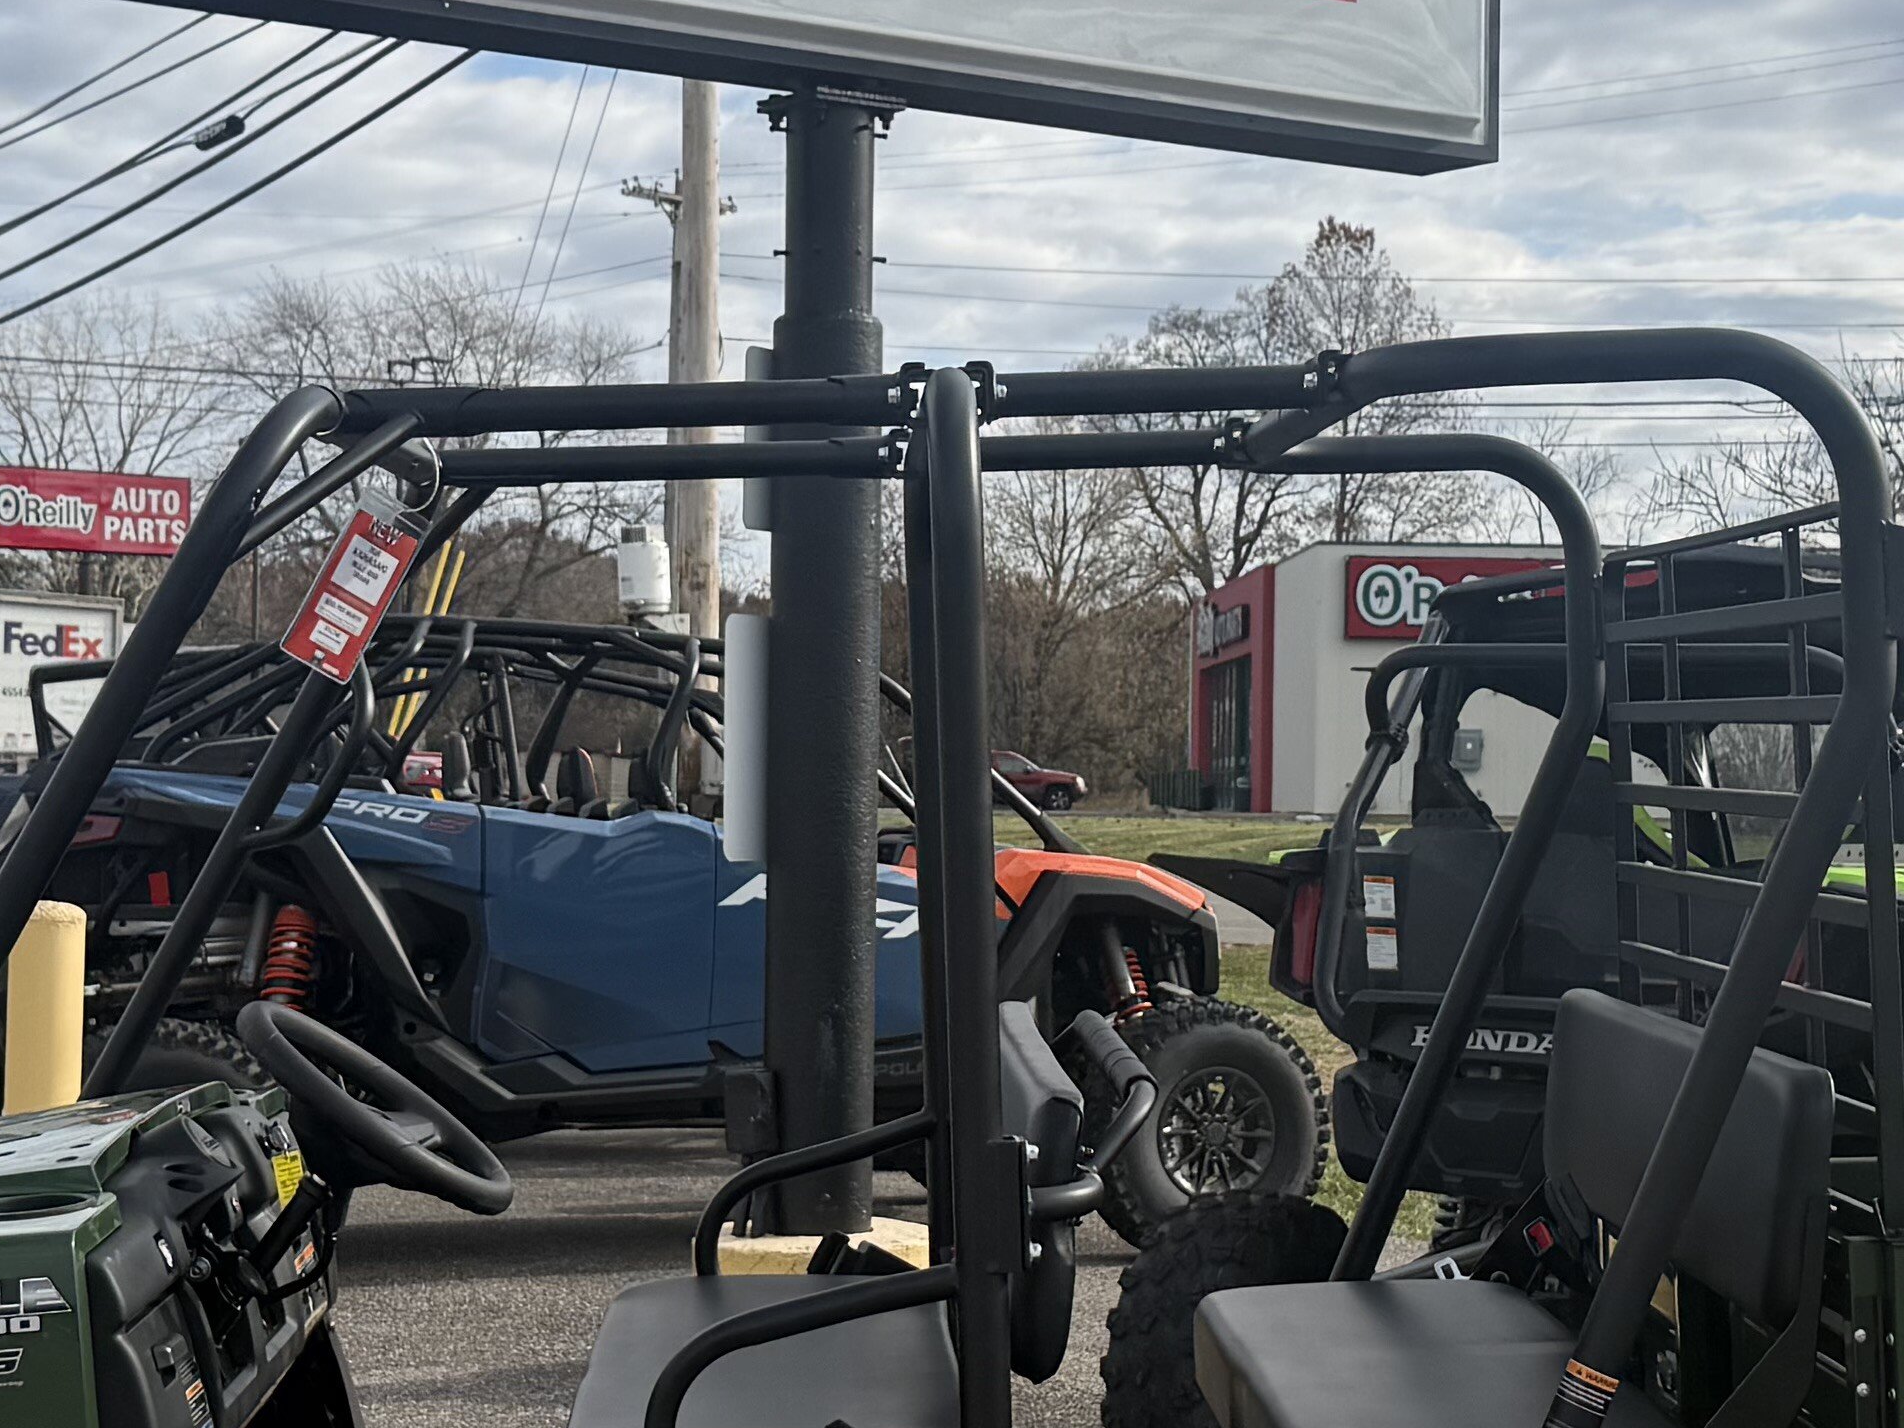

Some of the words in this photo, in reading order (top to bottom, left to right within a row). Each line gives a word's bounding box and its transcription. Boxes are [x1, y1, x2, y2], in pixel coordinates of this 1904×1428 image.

[111, 486, 181, 516] AUTO
[103, 515, 187, 545] PARTS
[2, 620, 104, 660] FedEx
